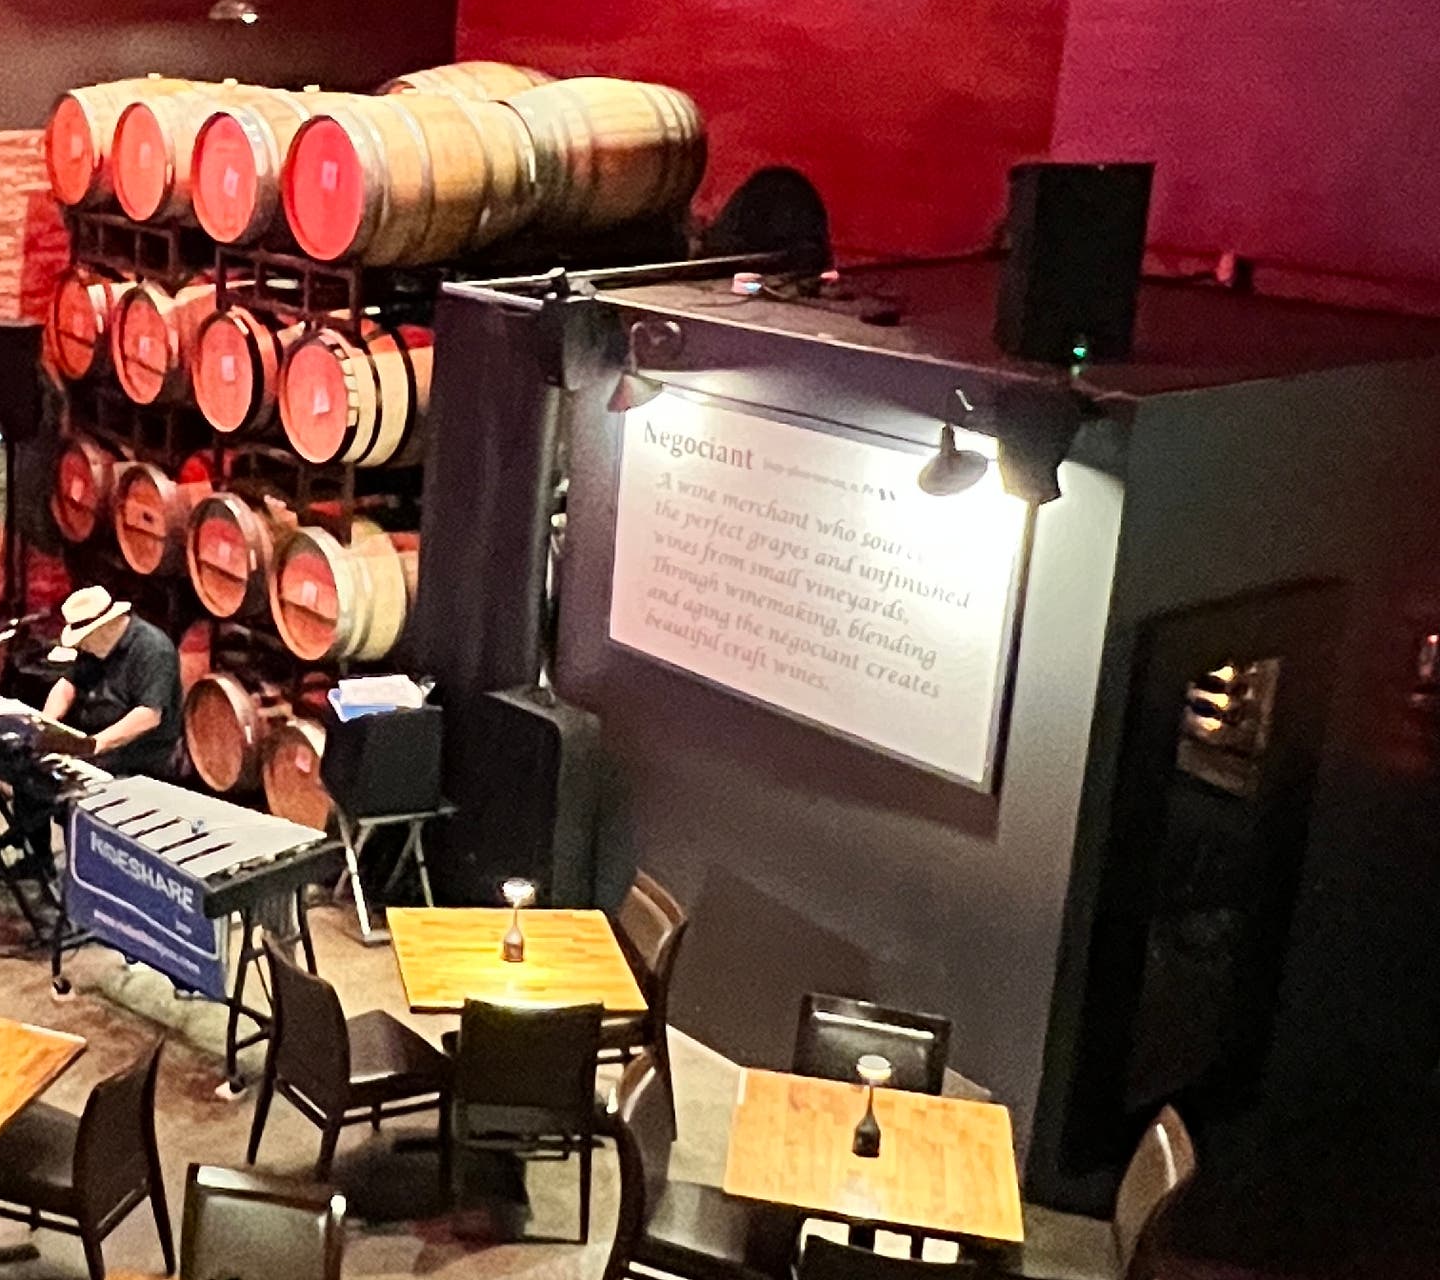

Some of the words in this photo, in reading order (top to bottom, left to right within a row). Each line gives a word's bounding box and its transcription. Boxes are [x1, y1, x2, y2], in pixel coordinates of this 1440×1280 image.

[644, 420, 754, 470] Negociant
[655, 500, 681, 521] the
[681, 511, 744, 542] perfect
[745, 531, 809, 561] grapes
[814, 552, 859, 575] and
[677, 480, 717, 503] wine
[723, 492, 809, 531] merchant
[815, 517, 857, 543] who
[654, 531, 699, 556] wines
[698, 542, 746, 572] from
[750, 562, 805, 588] small
[644, 608, 723, 651] beautiful
[722, 642, 768, 670] craft
[647, 586, 682, 607] and
[682, 599, 731, 630] aging
[735, 614, 763, 637] the
[768, 627, 860, 671] negociant
[865, 661, 942, 699] creates
[651, 555, 719, 594] Through
[847, 617, 937, 671] blending
